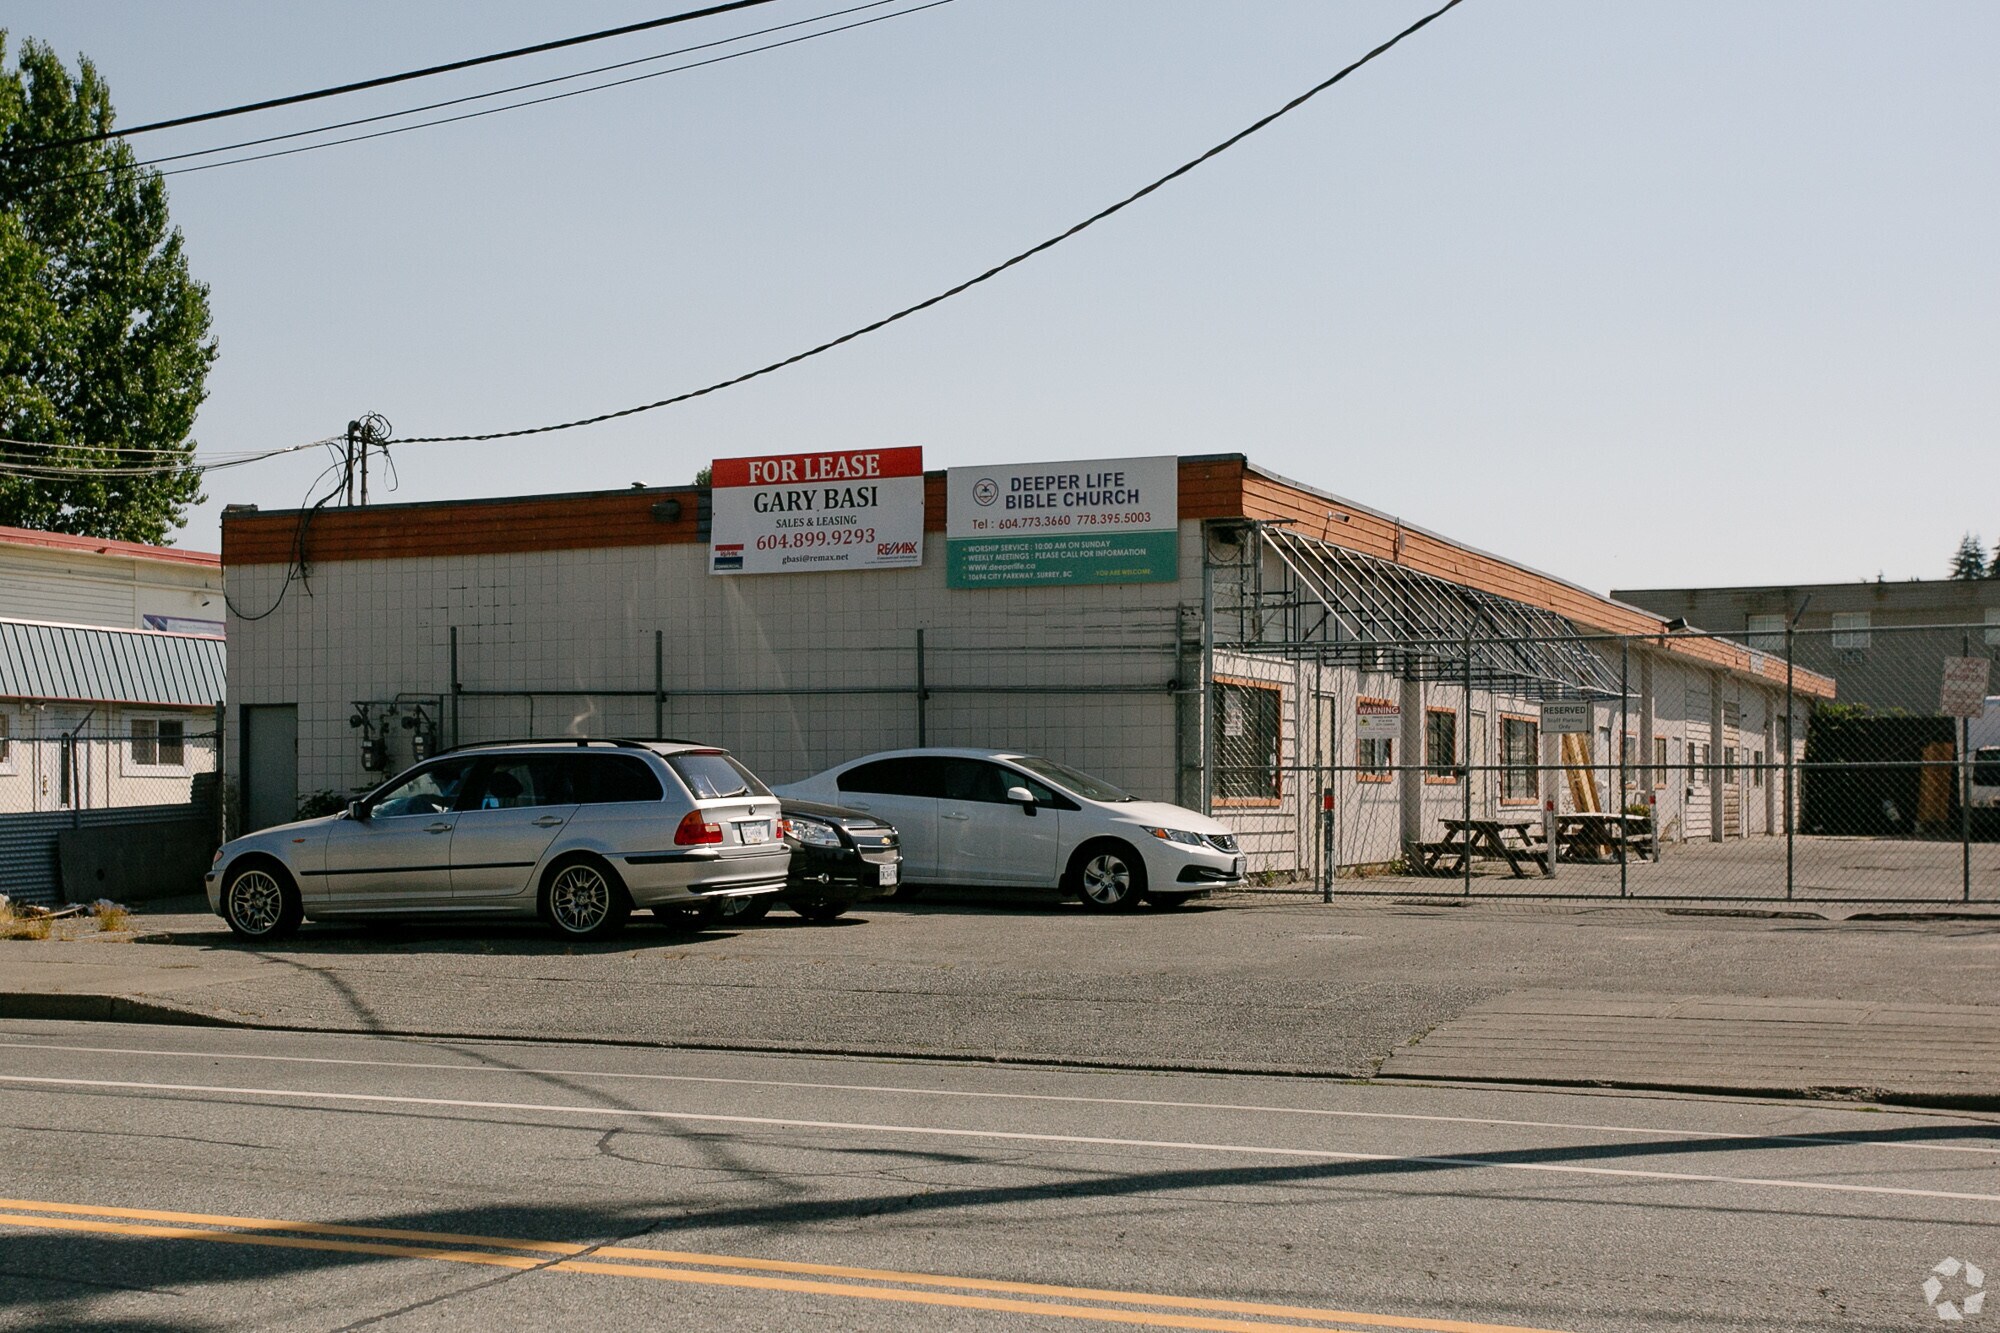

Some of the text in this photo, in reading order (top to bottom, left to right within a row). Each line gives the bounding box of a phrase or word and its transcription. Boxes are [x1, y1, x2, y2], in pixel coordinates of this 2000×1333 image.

[749, 454, 880, 483] FOR LEASE
[1010, 472, 1125, 492] DEEPER LIFE
[753, 486, 878, 513] GARY BASI
[1005, 489, 1140, 510] BIBLE CHURCH
[776, 515, 857, 529] SALES & LEASING
[972, 518, 988, 530] Tel
[998, 514, 1071, 530] 604.773.3660
[1076, 511, 1151, 526] 778.395.5003
[756, 527, 876, 551] 604.899.9293
[877, 541, 918, 556] RE/MAX
[968, 544, 999, 553] WORSHIP
[1000, 543, 1029, 551] SERVICE
[1034, 542, 1053, 550] 10:00
[1067, 541, 1080, 549] ON
[1081, 540, 1111, 548] SUNDAY
[781, 553, 849, 565] gbasi@remax.net
[968, 554, 994, 562] WEEKLY
[995, 552, 1030, 561] MEETINGS
[1034, 551, 1059, 559] PLEASE
[1060, 550, 1079, 559] CALL
[1095, 548, 1147, 557] INFORMATION
[1062, 570, 1073, 578] BC
[1359, 706, 1399, 714] WARNING
[1543, 706, 1586, 714] RESERVED
